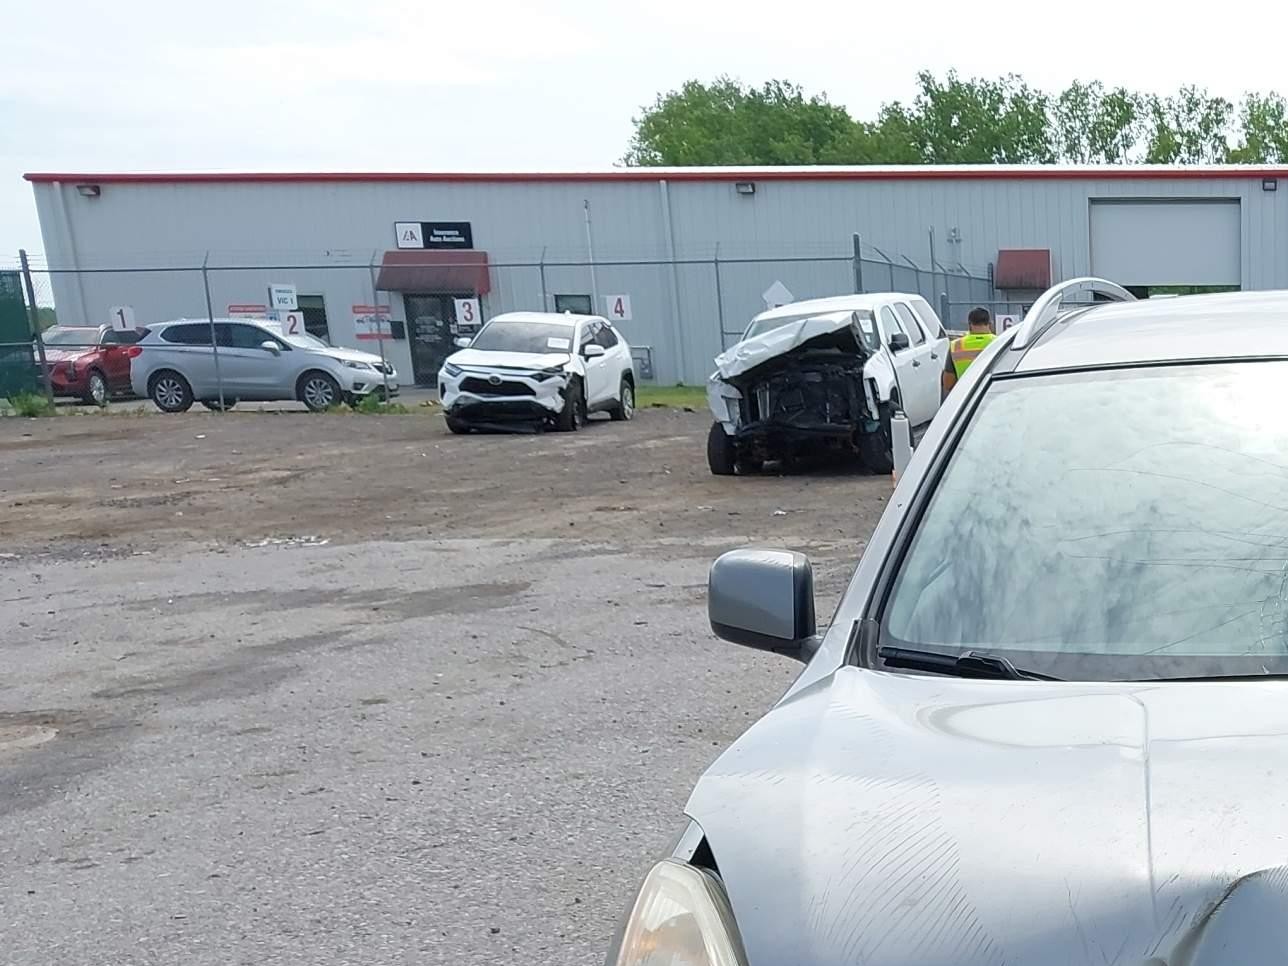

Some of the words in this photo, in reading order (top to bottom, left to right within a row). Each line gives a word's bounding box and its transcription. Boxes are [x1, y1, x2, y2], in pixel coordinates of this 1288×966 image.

[462, 302, 474, 322] 3
[614, 297, 625, 317] 4
[117, 309, 126, 328] 1
[287, 315, 298, 335] 2
